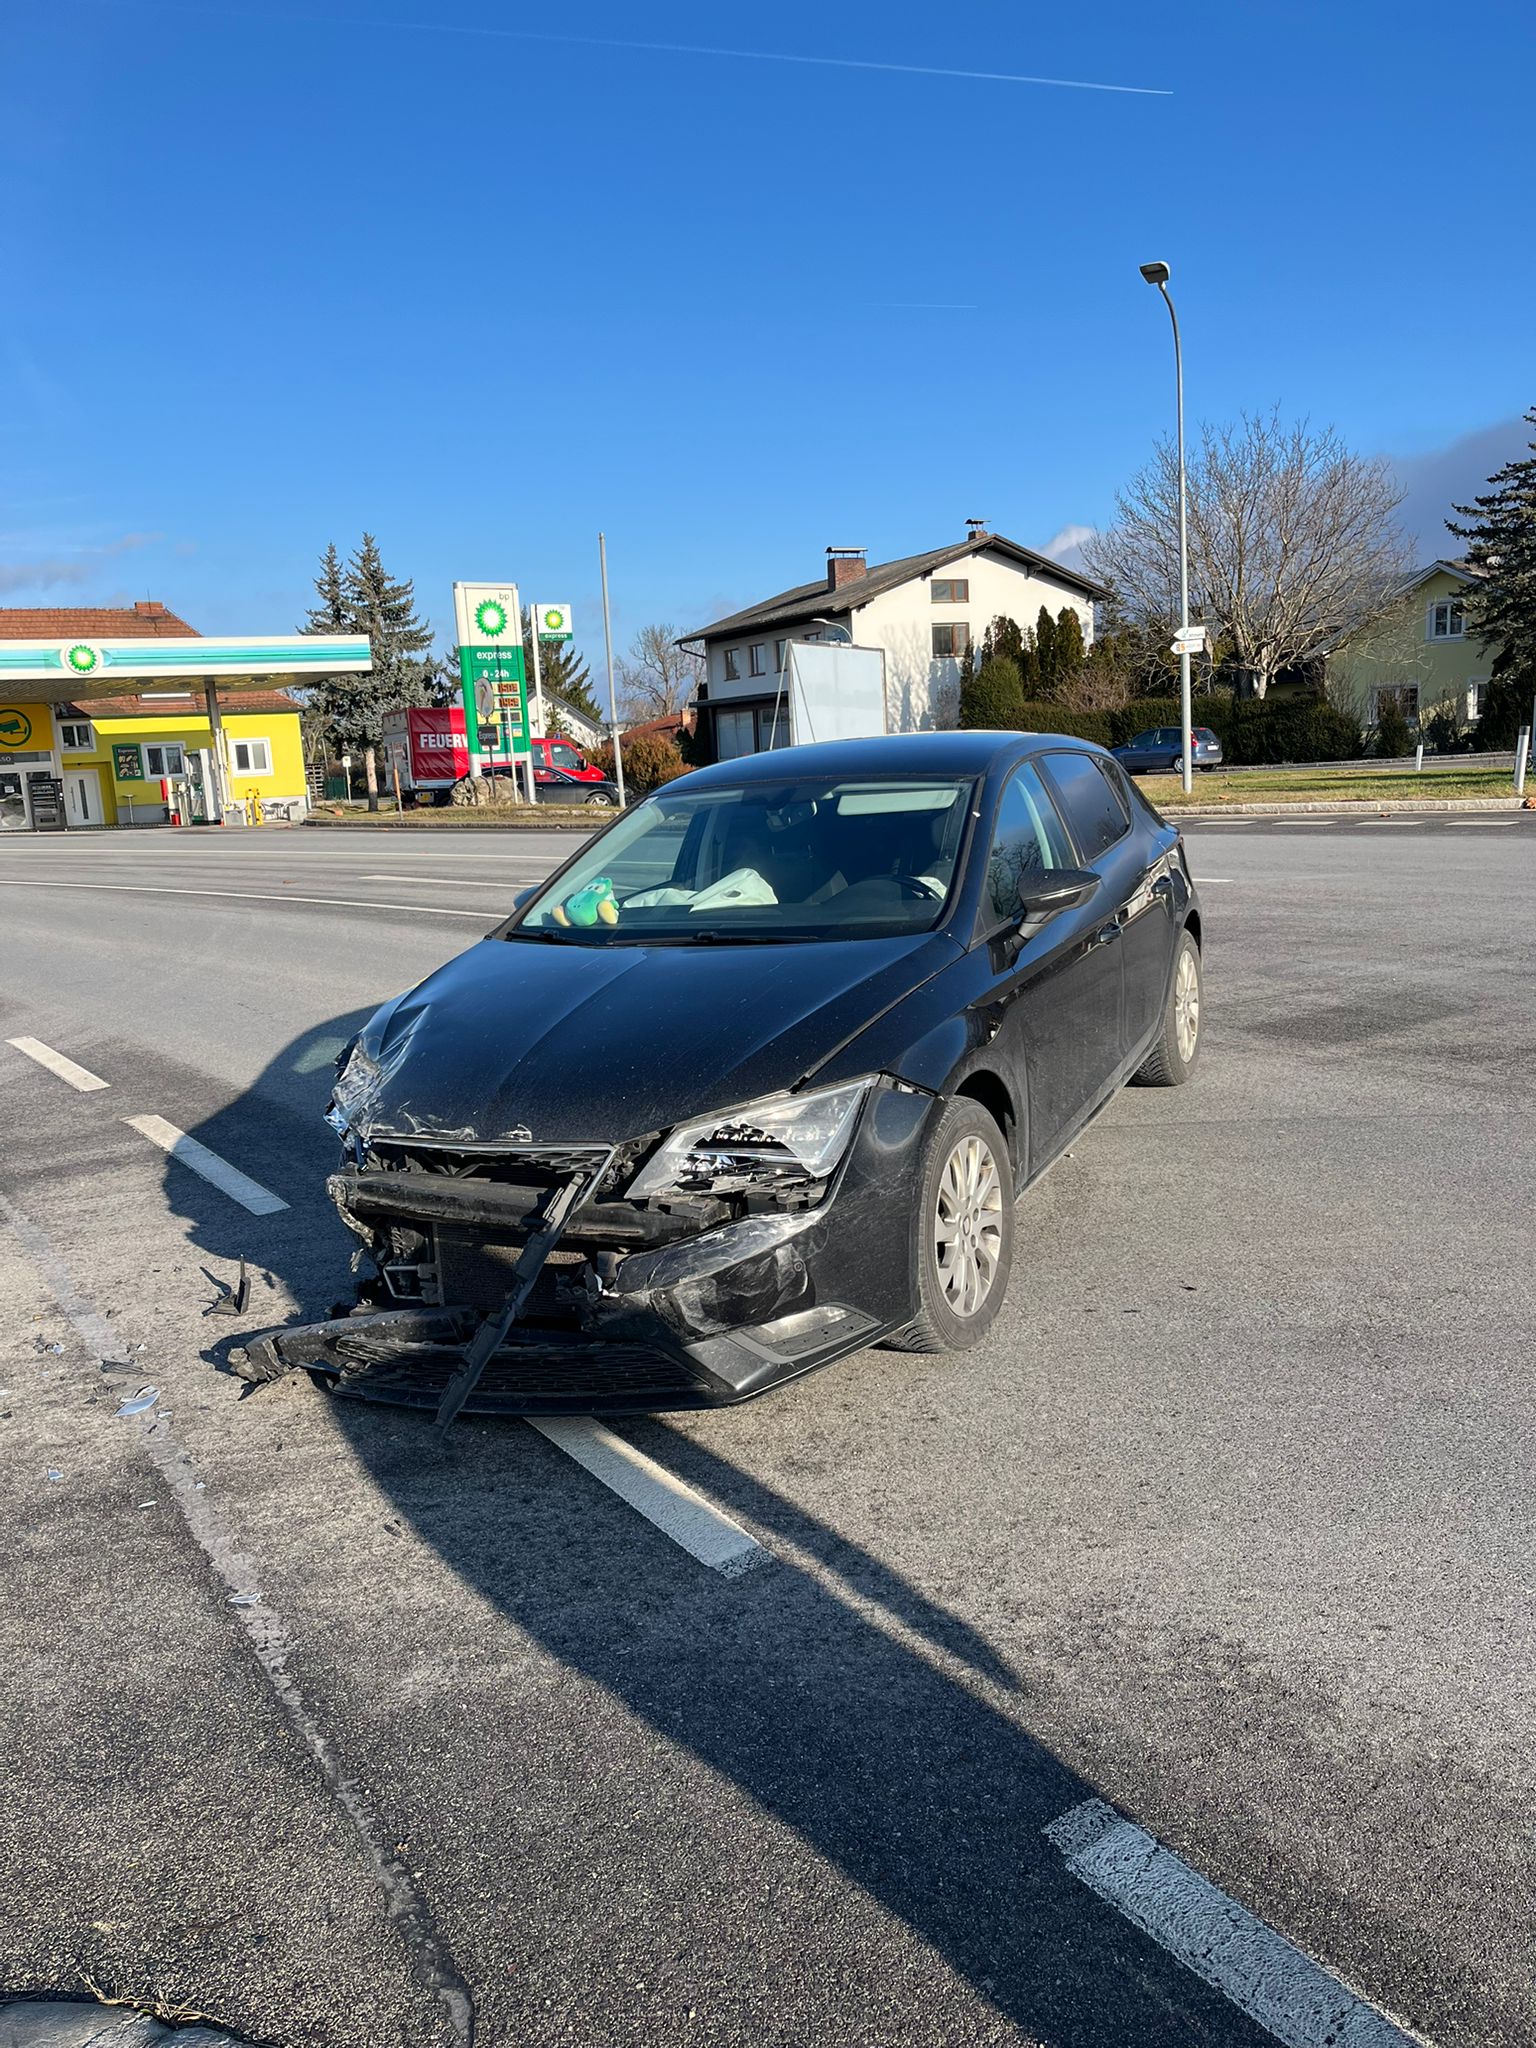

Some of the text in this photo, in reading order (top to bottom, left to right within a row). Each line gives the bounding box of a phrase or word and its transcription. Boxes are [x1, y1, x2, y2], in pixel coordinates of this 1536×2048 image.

[499, 592, 510, 601] bp
[476, 651, 513, 661] express
[494, 669, 509, 678] 24h
